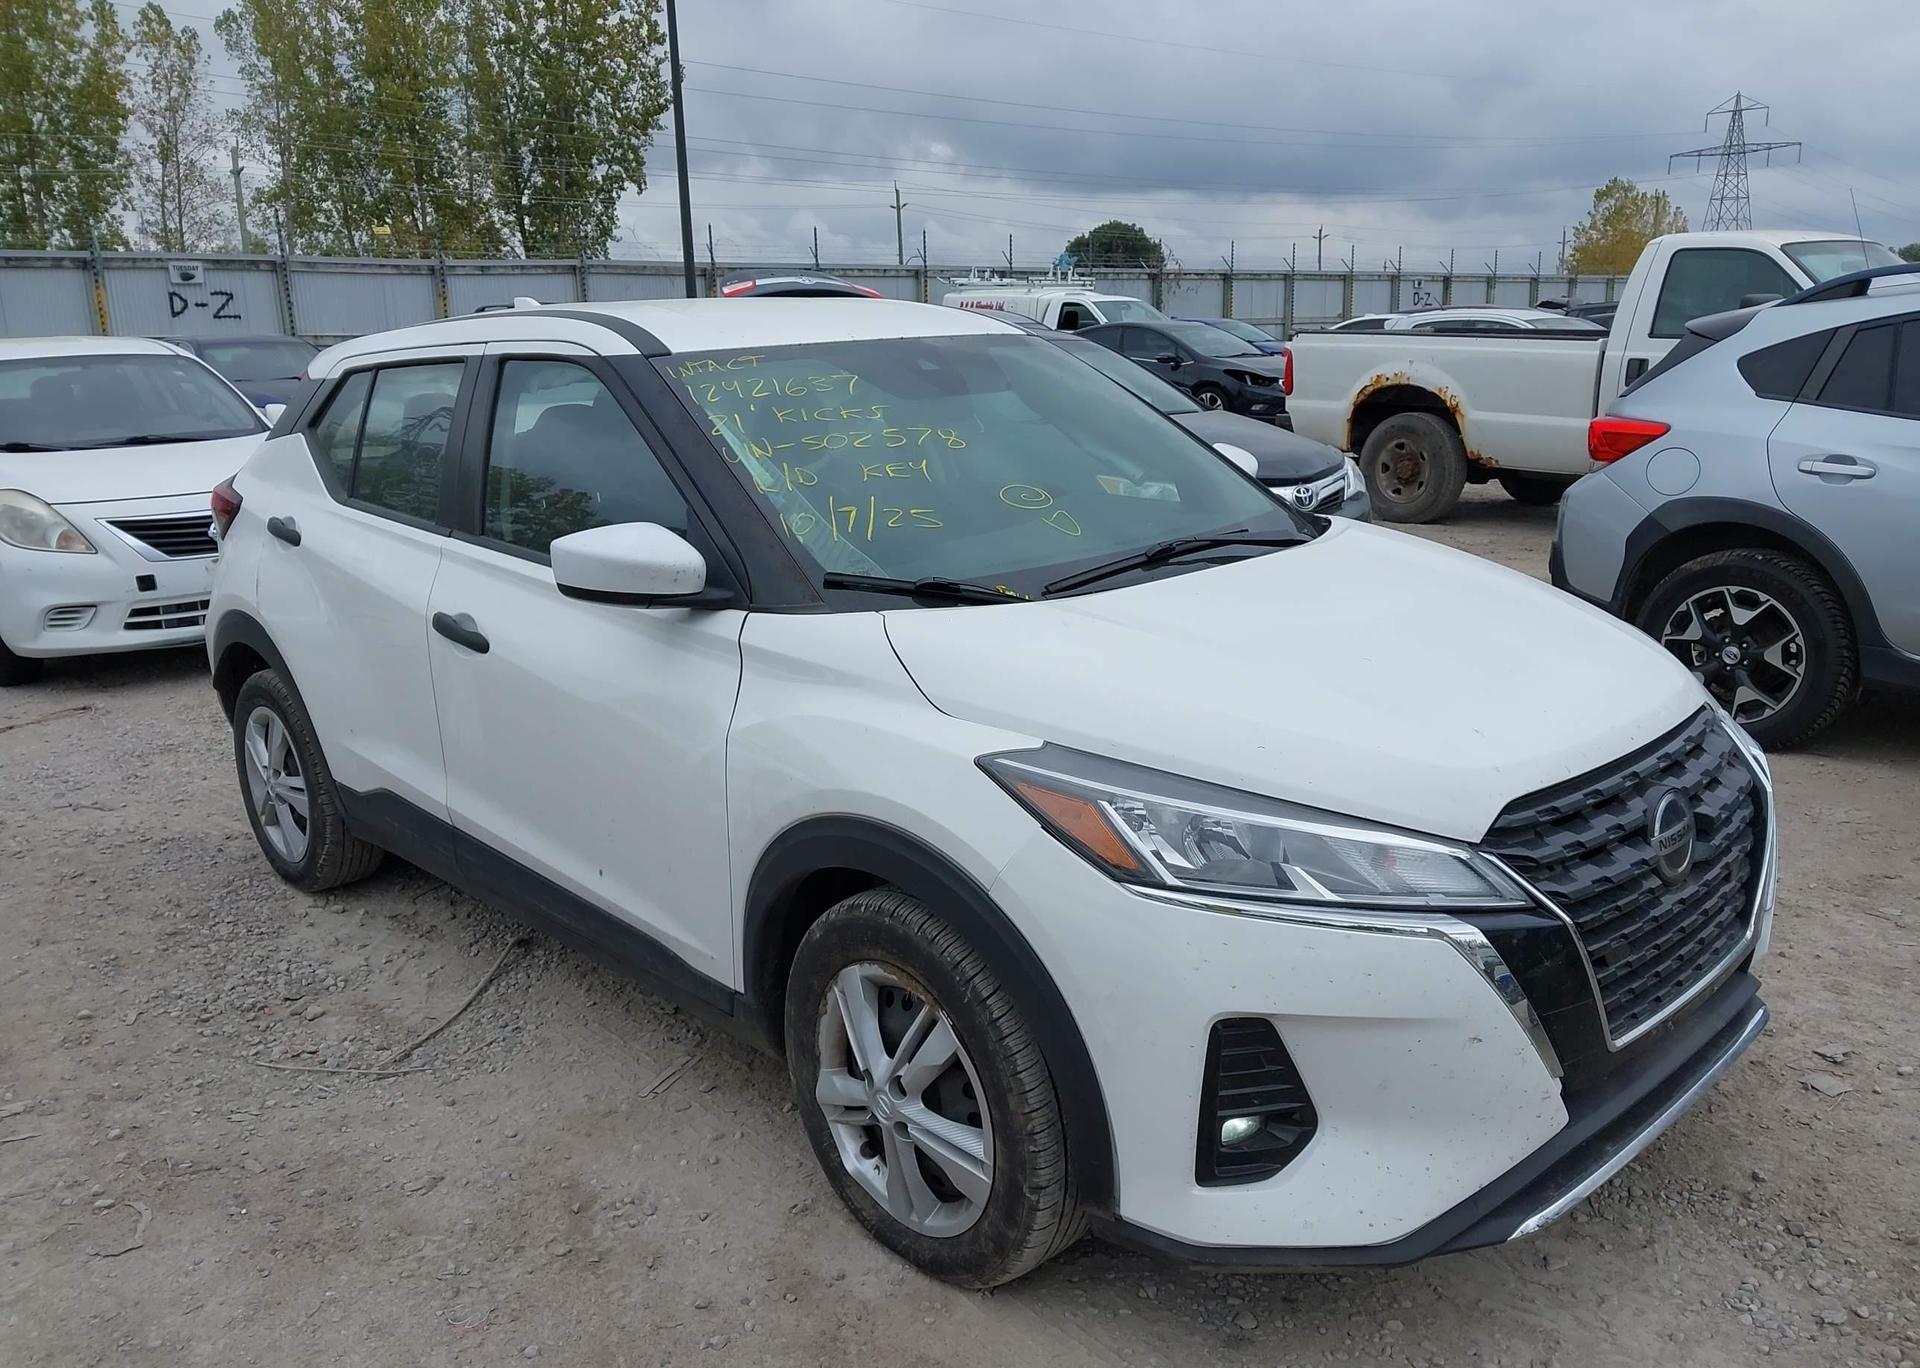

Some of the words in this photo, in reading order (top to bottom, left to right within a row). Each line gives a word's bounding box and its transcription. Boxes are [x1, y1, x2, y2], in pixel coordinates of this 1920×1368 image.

[168, 291, 242, 320] D-Z
[665, 355, 765, 379] INTACT
[685, 375, 858, 405] 12421637
[772, 404, 888, 423] KICKS
[860, 458, 932, 483] KEY
[779, 495, 944, 542] 10/7/25
